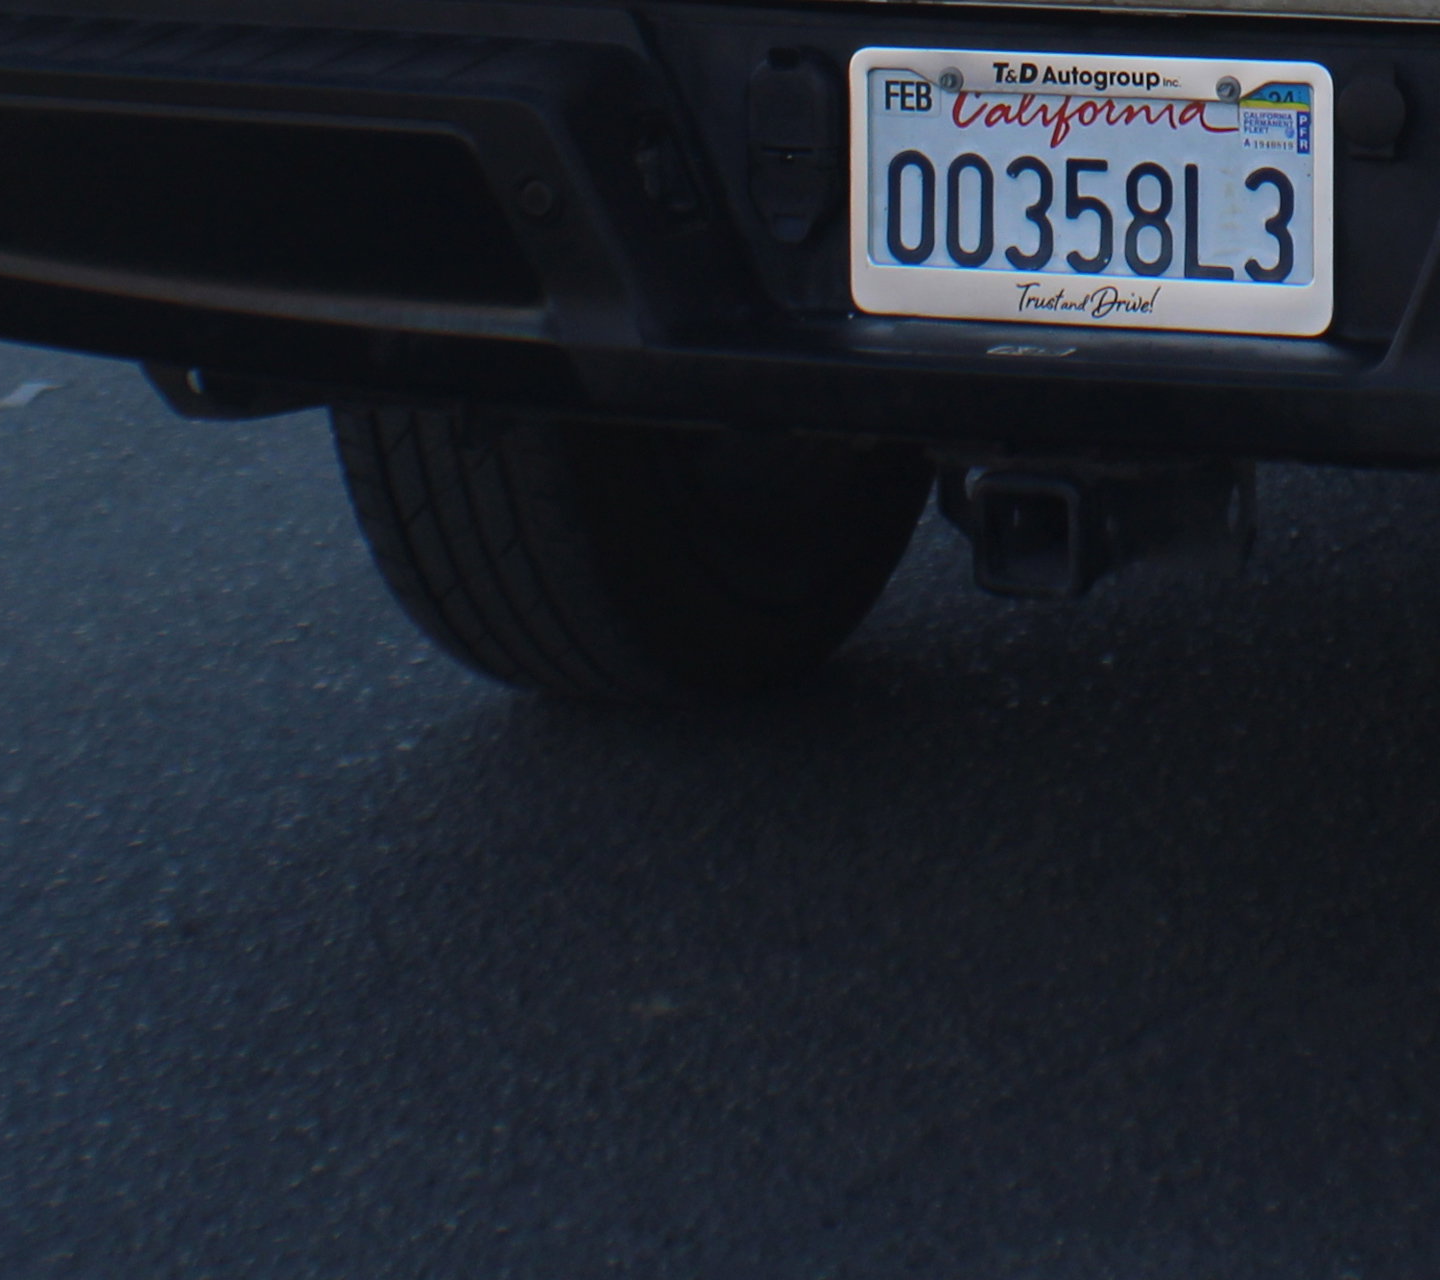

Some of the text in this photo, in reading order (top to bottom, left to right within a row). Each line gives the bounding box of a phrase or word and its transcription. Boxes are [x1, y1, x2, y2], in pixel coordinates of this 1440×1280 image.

[992, 62, 1182, 91] T&D Autogroup Inc.
[884, 80, 933, 113] FEB
[952, 91, 1239, 148] California
[886, 150, 1295, 283] 00358L3
[1015, 282, 1162, 319] Trust and Drive!
